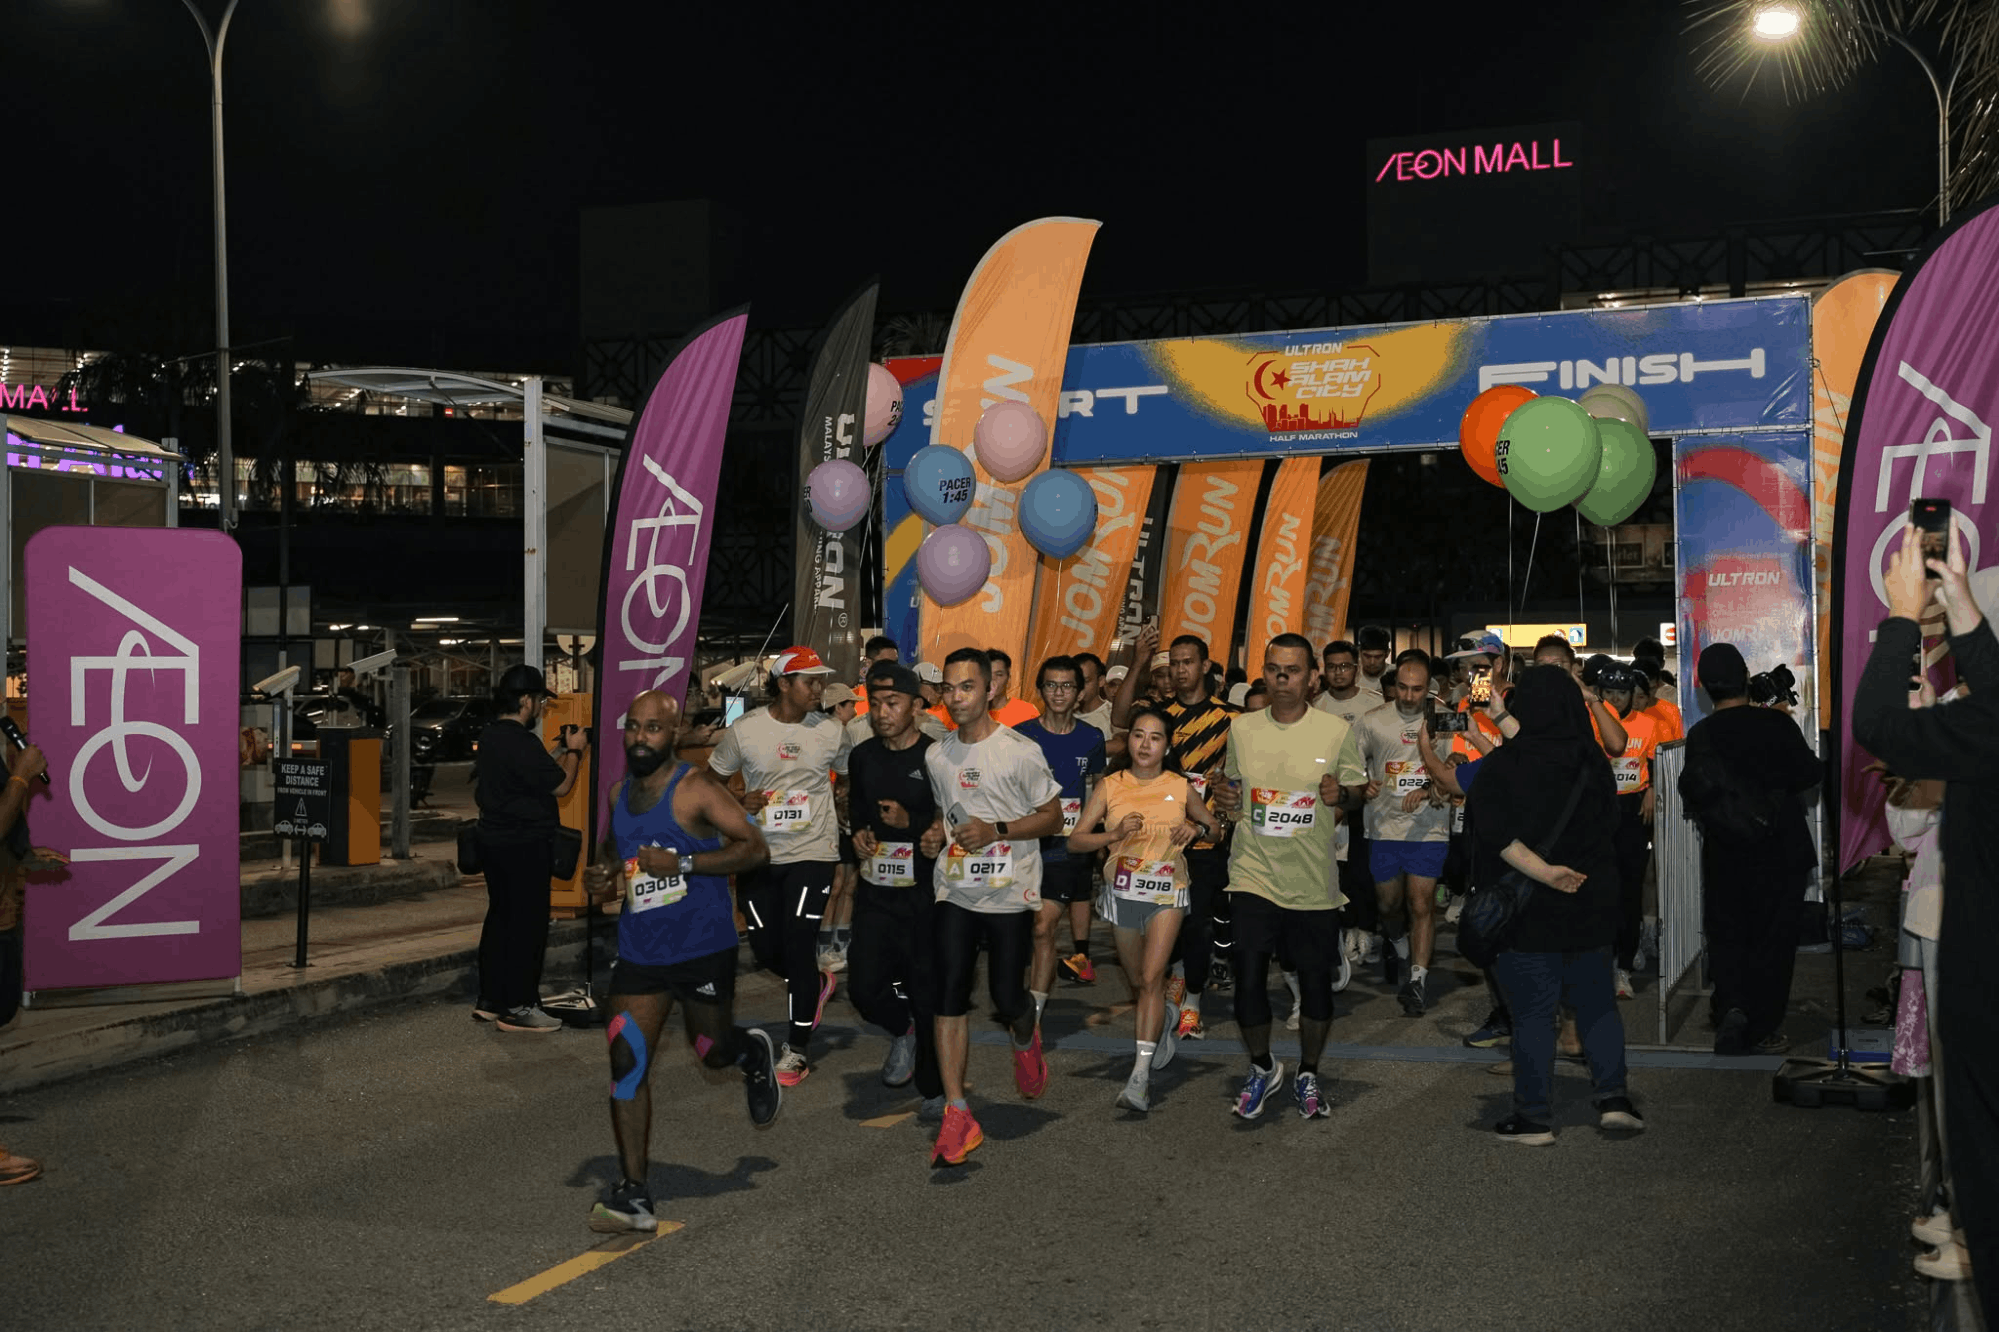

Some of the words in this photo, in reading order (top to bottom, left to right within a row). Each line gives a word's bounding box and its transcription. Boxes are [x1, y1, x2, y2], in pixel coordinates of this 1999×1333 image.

[1474, 138, 1573, 174] MALL
[1285, 342, 1343, 357] ULTRON
[1290, 357, 1372, 374] SHAH
[1478, 347, 1766, 393] FINISH
[1287, 370, 1373, 388] ALAM
[0, 381, 89, 412] MAL
[922, 385, 1169, 426] SRT
[823, 416, 833, 462] MALAYS
[1269, 434, 1297, 443] HALF
[1298, 431, 1359, 442] MARATHON
[939, 476, 971, 491] PACER
[962, 354, 1035, 614] JOMN
[943, 489, 968, 504] 1:45
[819, 413, 855, 609] ULON
[1179, 475, 1242, 647] JOMRUN
[1121, 517, 1154, 646] TRON
[1264, 512, 1303, 646] OMRUN
[1708, 571, 1780, 587] ULTRON
[1303, 534, 1347, 656] OMRUN
[281, 763, 300, 774] KEEP
[300, 764, 306, 775] A
[306, 765, 325, 776] SAFE
[1615, 773, 1637, 782] 014
[285, 775, 319, 787] DISTANCE
[289, 788, 307, 796] VEHICLE
[306, 788, 312, 796] IN
[312, 789, 327, 797] FRONT
[774, 809, 802, 820] 0131
[1268, 811, 1313, 824] 2048
[878, 863, 906, 875] 0115
[949, 862, 961, 876] A
[970, 862, 1007, 875] 0217
[635, 876, 680, 897] 0308
[1115, 874, 1128, 887] D
[1134, 878, 1172, 892] 3018
